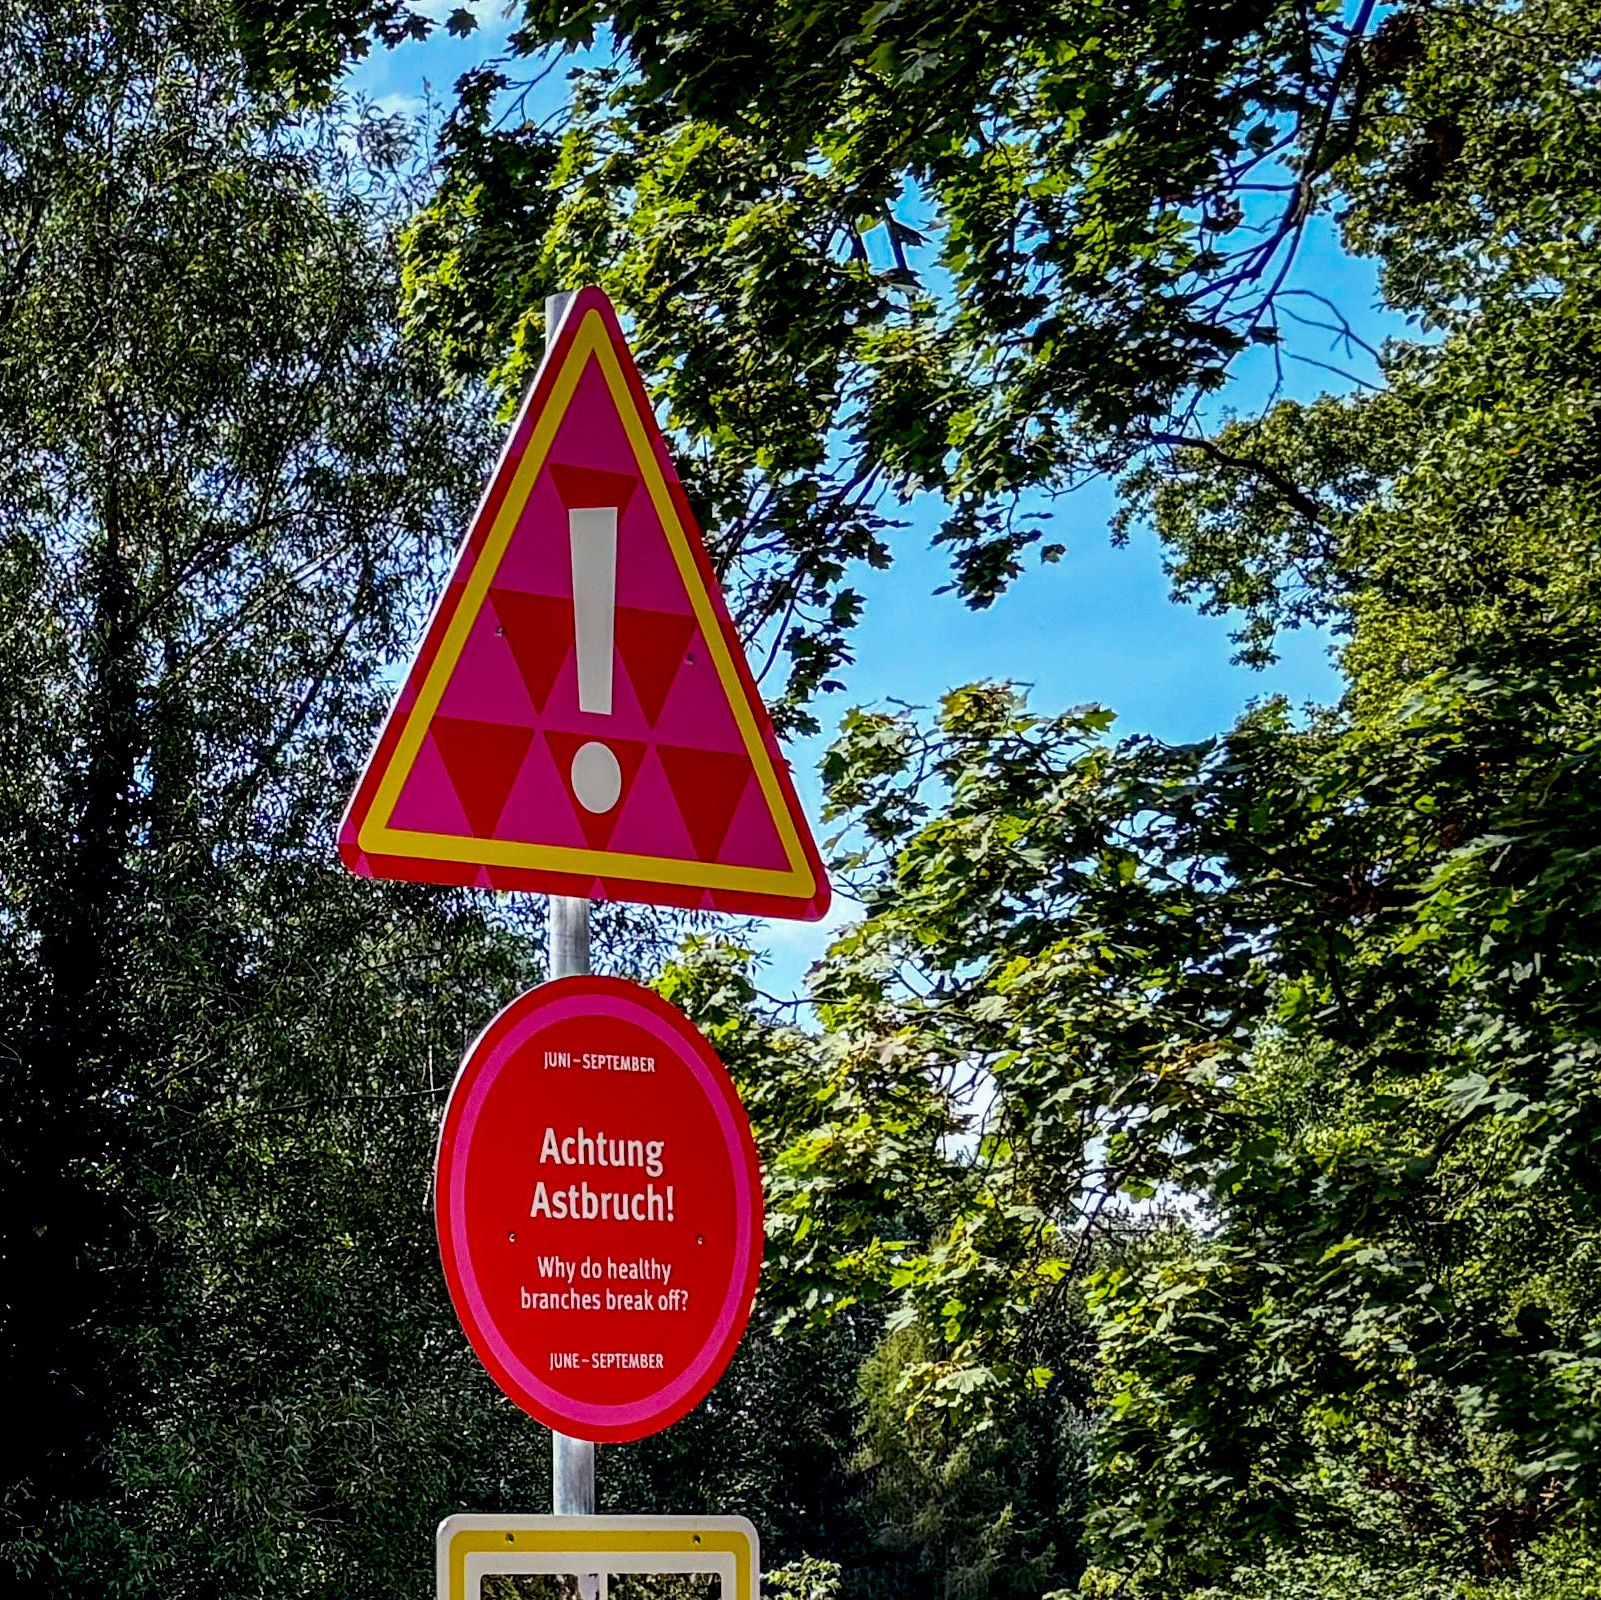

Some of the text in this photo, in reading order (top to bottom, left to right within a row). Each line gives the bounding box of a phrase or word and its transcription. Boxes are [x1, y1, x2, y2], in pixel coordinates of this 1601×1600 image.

[539, 1126, 665, 1178] Achtung
[529, 1181, 675, 1222] Astbruch!
[537, 1255, 672, 1285] Why do healthy
[520, 1286, 689, 1312] branches break off?
